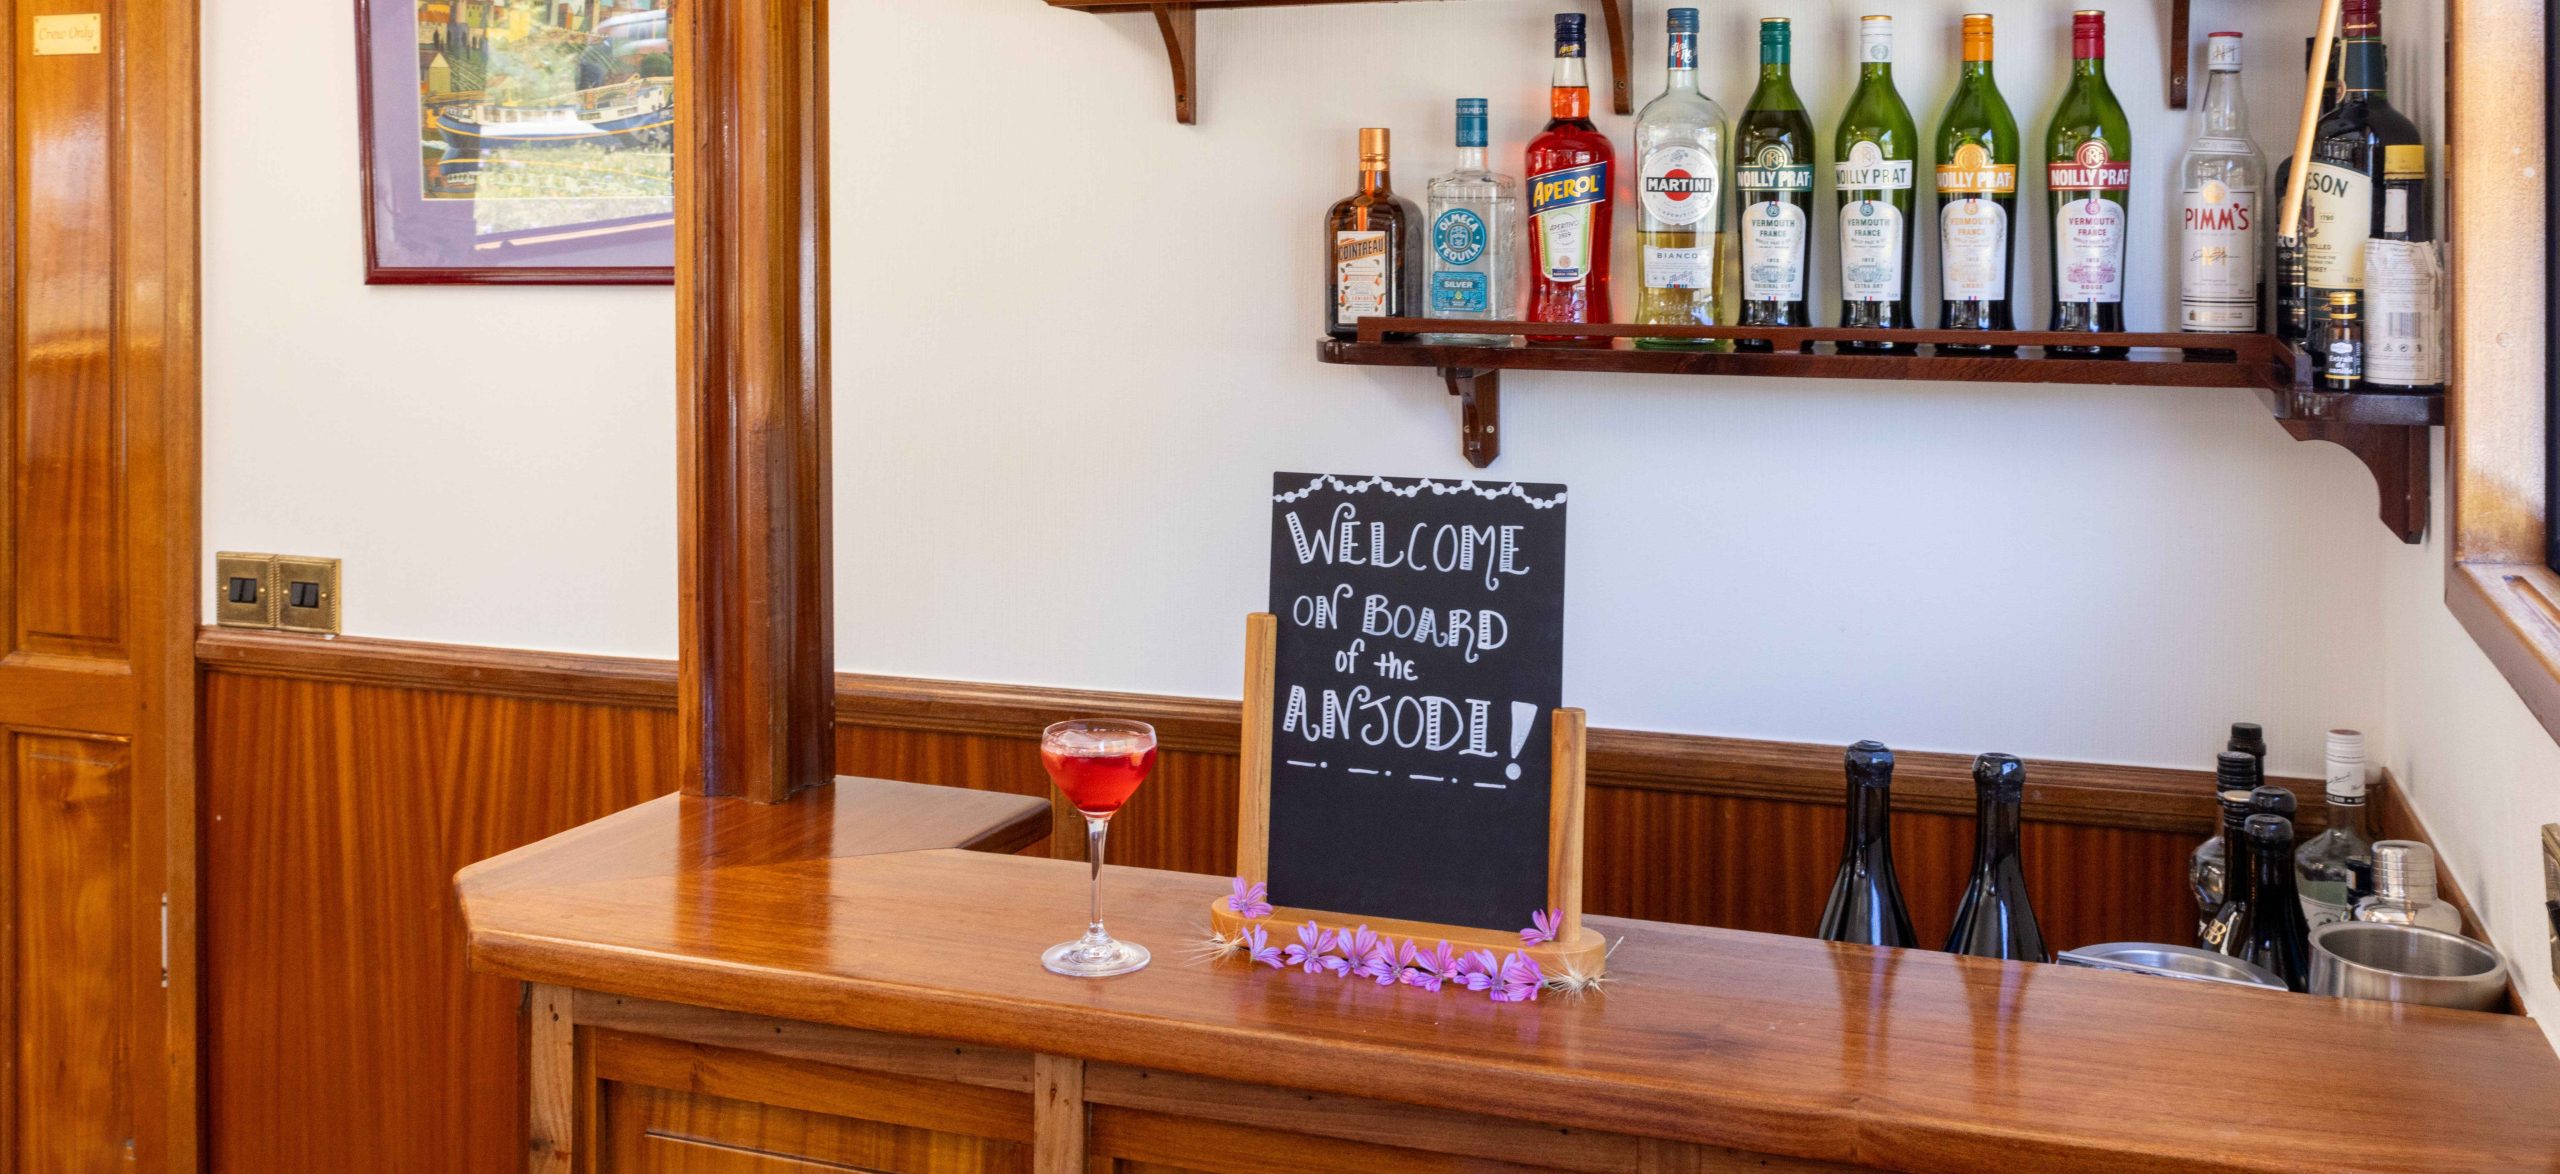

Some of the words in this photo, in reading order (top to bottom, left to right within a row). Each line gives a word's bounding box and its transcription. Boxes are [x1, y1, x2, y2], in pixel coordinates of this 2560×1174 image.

[39, 27, 66, 40] Crew
[69, 26, 94, 42] Only
[1647, 178, 1710, 191] MARTINI
[1737, 171, 1776, 187] NOILLY
[1778, 171, 1810, 187] PRAT
[1836, 169, 1869, 184] NOILLY
[1873, 168, 1907, 183] PRAT
[1936, 172, 1974, 187] NOILLY
[1977, 172, 2011, 188] PRAT
[2051, 169, 2097, 185] NOILLY
[2099, 169, 2128, 185] PRAT
[1533, 175, 1599, 208] APEROL
[1439, 213, 1480, 232] OLMECA
[2185, 203, 2249, 230] PIMM'S
[2078, 228, 2106, 236] FRANCE
[1338, 238, 1384, 261] COINTREAU
[1439, 242, 1481, 261] TEQUILA
[1286, 502, 1530, 591] WELCOME
[1293, 583, 1353, 630] ON
[1362, 594, 1508, 661] BOARD
[1335, 639, 1365, 674] of
[1373, 651, 1418, 681] the
[1282, 685, 1538, 781] ANJODI!
